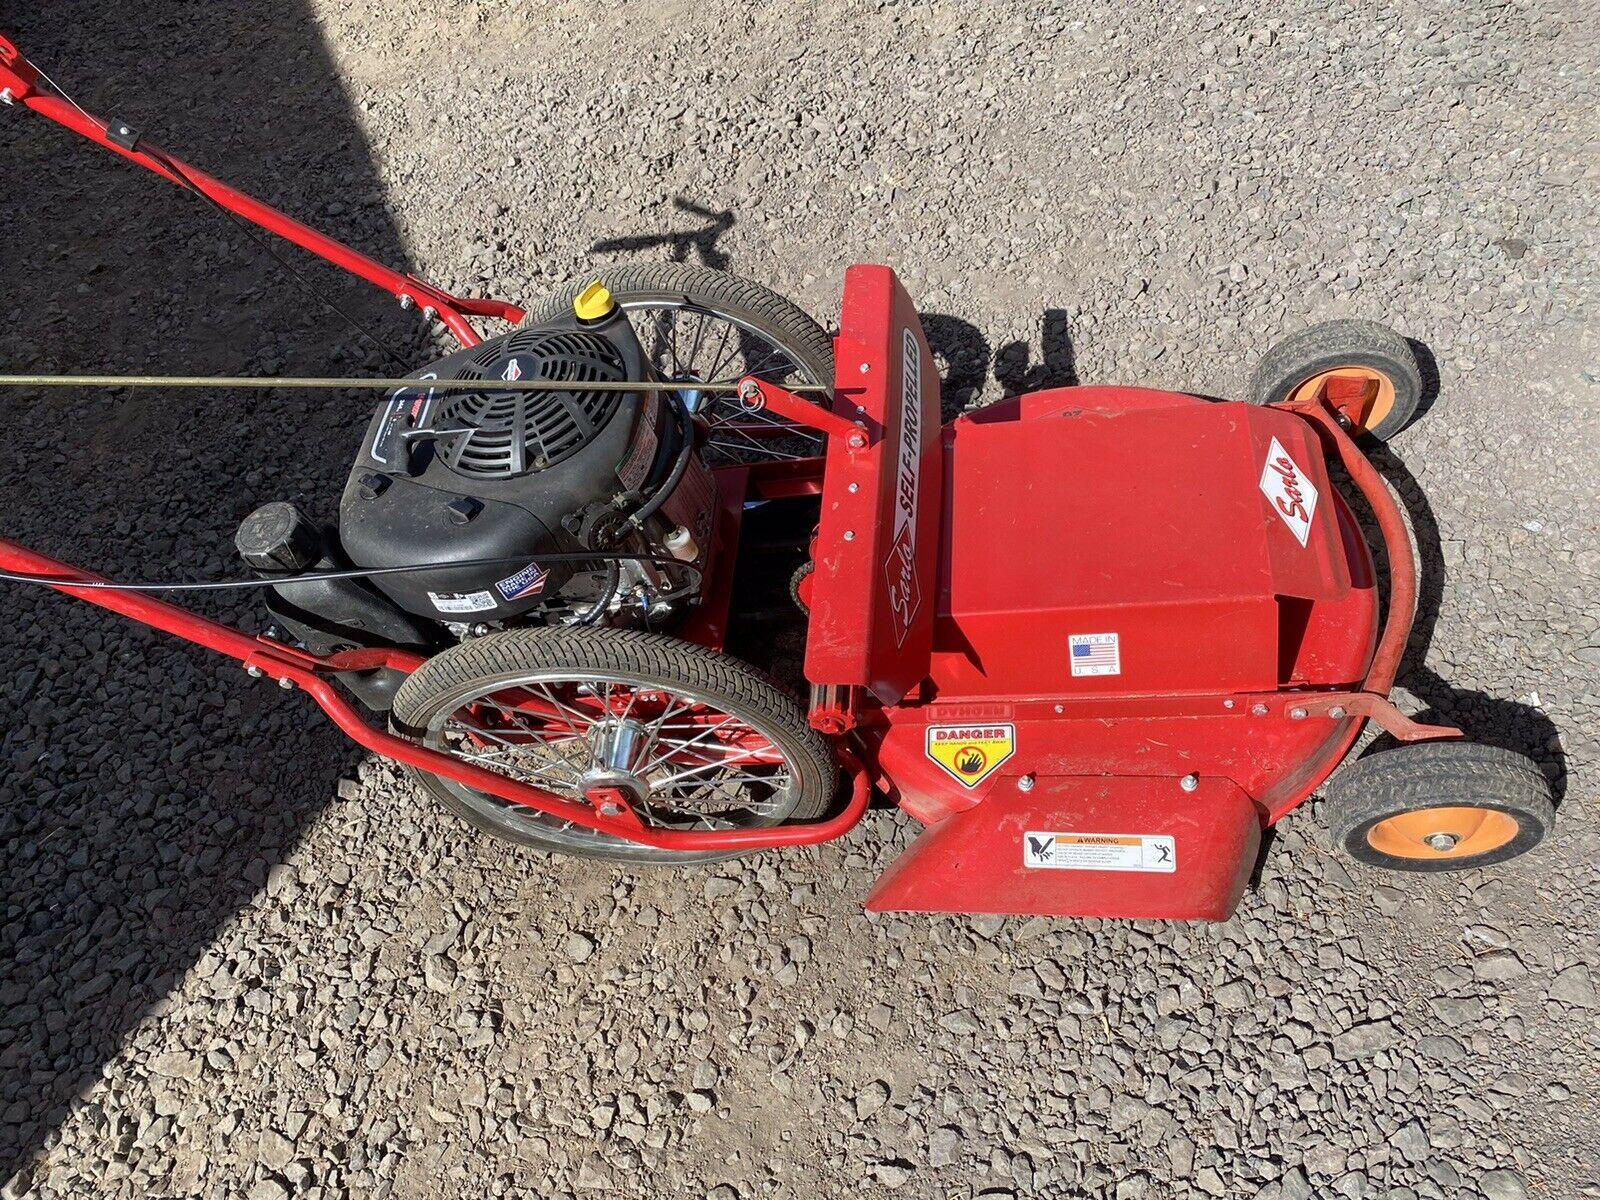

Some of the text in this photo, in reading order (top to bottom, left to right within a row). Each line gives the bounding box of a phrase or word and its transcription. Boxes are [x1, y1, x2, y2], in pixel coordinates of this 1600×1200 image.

[899, 332, 918, 518] SELF-PROPELLED
[1269, 457, 1309, 524] Sarlo
[498, 565, 535, 588] ENGINE
[501, 574, 526, 591] MADE
[891, 543, 912, 628] Sarlo
[1072, 635, 1116, 645] MADE IN
[936, 729, 1006, 740] DANGER
